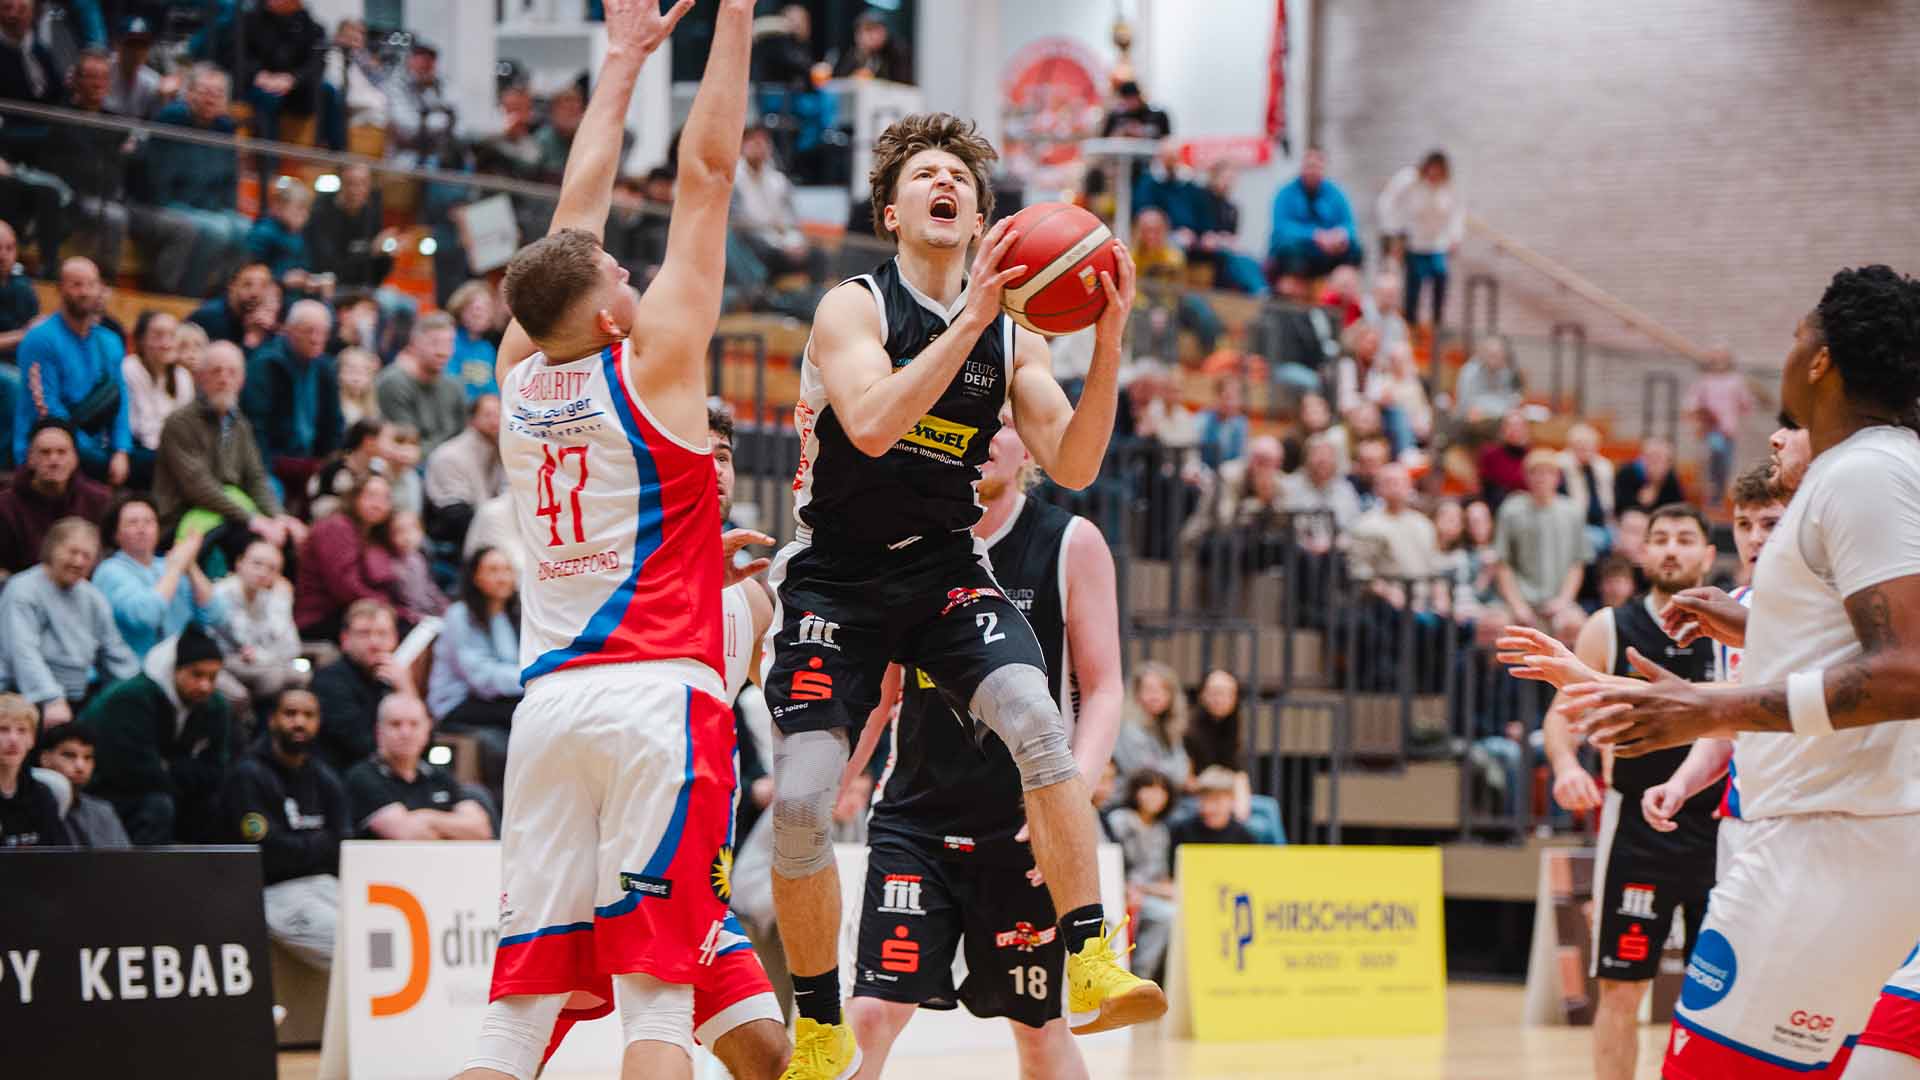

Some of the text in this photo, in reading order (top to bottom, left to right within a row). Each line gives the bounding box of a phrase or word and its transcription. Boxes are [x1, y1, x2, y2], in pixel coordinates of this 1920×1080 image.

[964, 372, 996, 388] DENT
[536, 443, 589, 547] 47
[799, 614, 841, 644] fit
[975, 611, 1006, 645] 2
[883, 880, 922, 910] fit
[1264, 902, 1416, 931] HIRSCHHORN
[0, 943, 253, 1004] Y KEBAB
[1007, 965, 1048, 1000] 18
